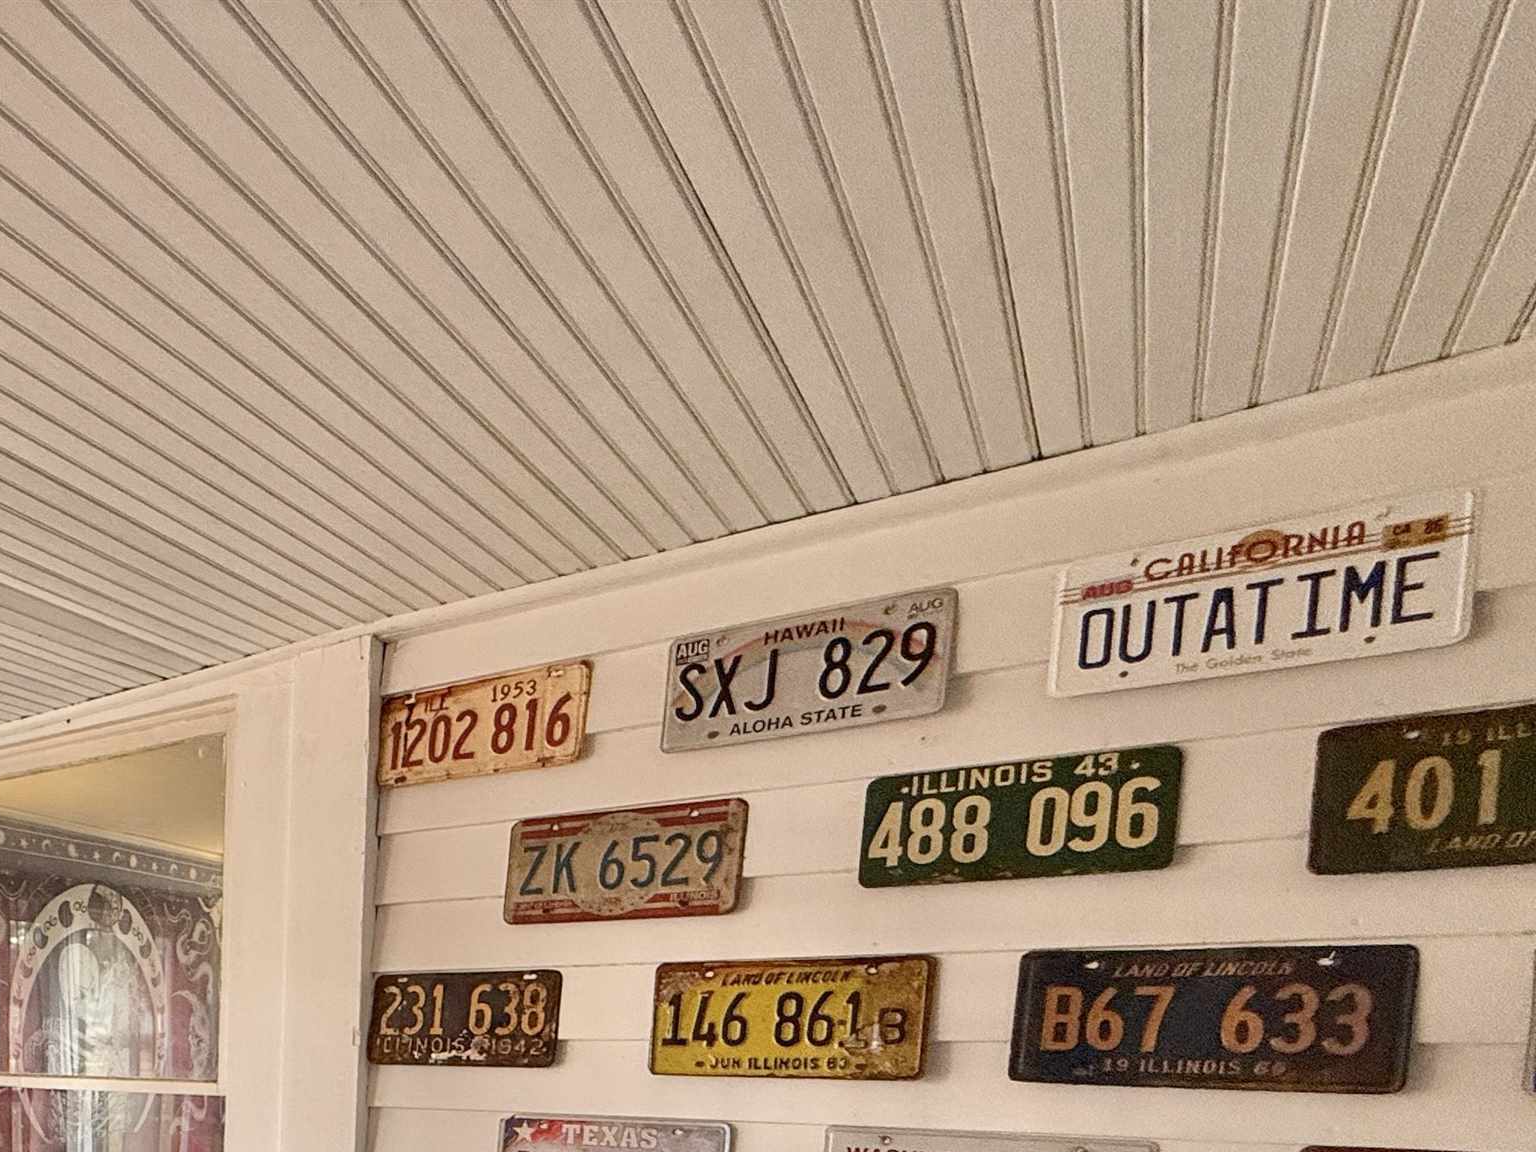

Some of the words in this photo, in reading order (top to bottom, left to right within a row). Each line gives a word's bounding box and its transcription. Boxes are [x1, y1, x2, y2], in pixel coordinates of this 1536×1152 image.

[1143, 520, 1366, 583] CALIFORNIA
[907, 599, 944, 615] AUG
[1077, 551, 1440, 670] OUTATIME
[764, 617, 845, 646] HAWAII
[676, 639, 710, 659] AUG
[1206, 654, 1263, 671] Golden
[1271, 646, 1313, 663] State
[674, 648, 779, 721] SXJ
[818, 621, 937, 700] 829
[491, 679, 537, 703] 1953
[390, 709, 479, 770] 1202
[490, 692, 572, 754] 816
[729, 716, 794, 736] ALOHA
[800, 704, 863, 726] STATE
[911, 760, 1054, 796] ILLINOIS
[1073, 752, 1120, 778] 43
[1345, 749, 1502, 834] 401
[867, 795, 992, 867] 488
[1025, 776, 1162, 857] 096
[520, 841, 582, 896] ZK
[598, 829, 723, 890] 6529
[786, 969, 852, 985] LINCOLN
[1113, 962, 1173, 978] LAND
[1174, 962, 1201, 978] OF
[1204, 960, 1294, 977] LINCOLN
[379, 984, 445, 1036] 231
[468, 982, 547, 1036] 638
[662, 990, 748, 1048] 146
[1040, 984, 1178, 1053] B67
[1219, 982, 1373, 1056] 633
[492, 1037, 546, 1055] 1942
[748, 1057, 819, 1070] ILLINOIS
[1138, 1059, 1242, 1075] ILLINOIS
[561, 1123, 658, 1149] TEXAS
